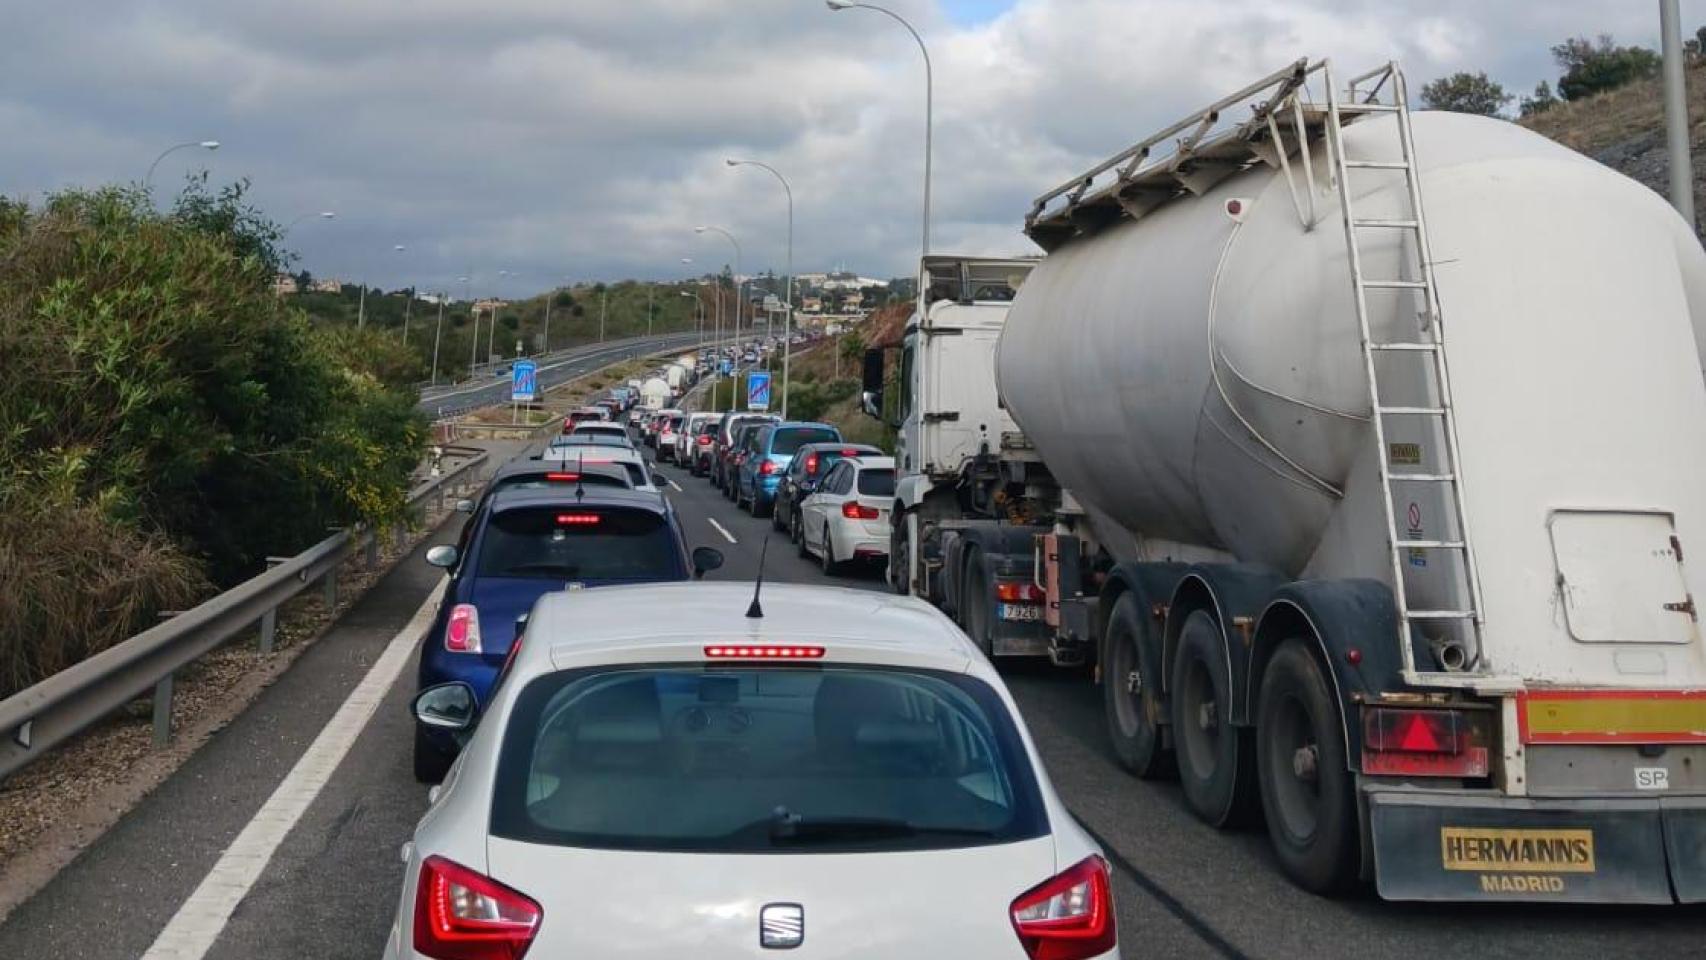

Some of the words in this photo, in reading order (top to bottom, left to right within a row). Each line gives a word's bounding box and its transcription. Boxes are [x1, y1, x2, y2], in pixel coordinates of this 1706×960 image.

[1638, 771, 1666, 786] SP
[1446, 836, 1588, 864] HERMANNS
[1480, 876, 1563, 893] MADRID
